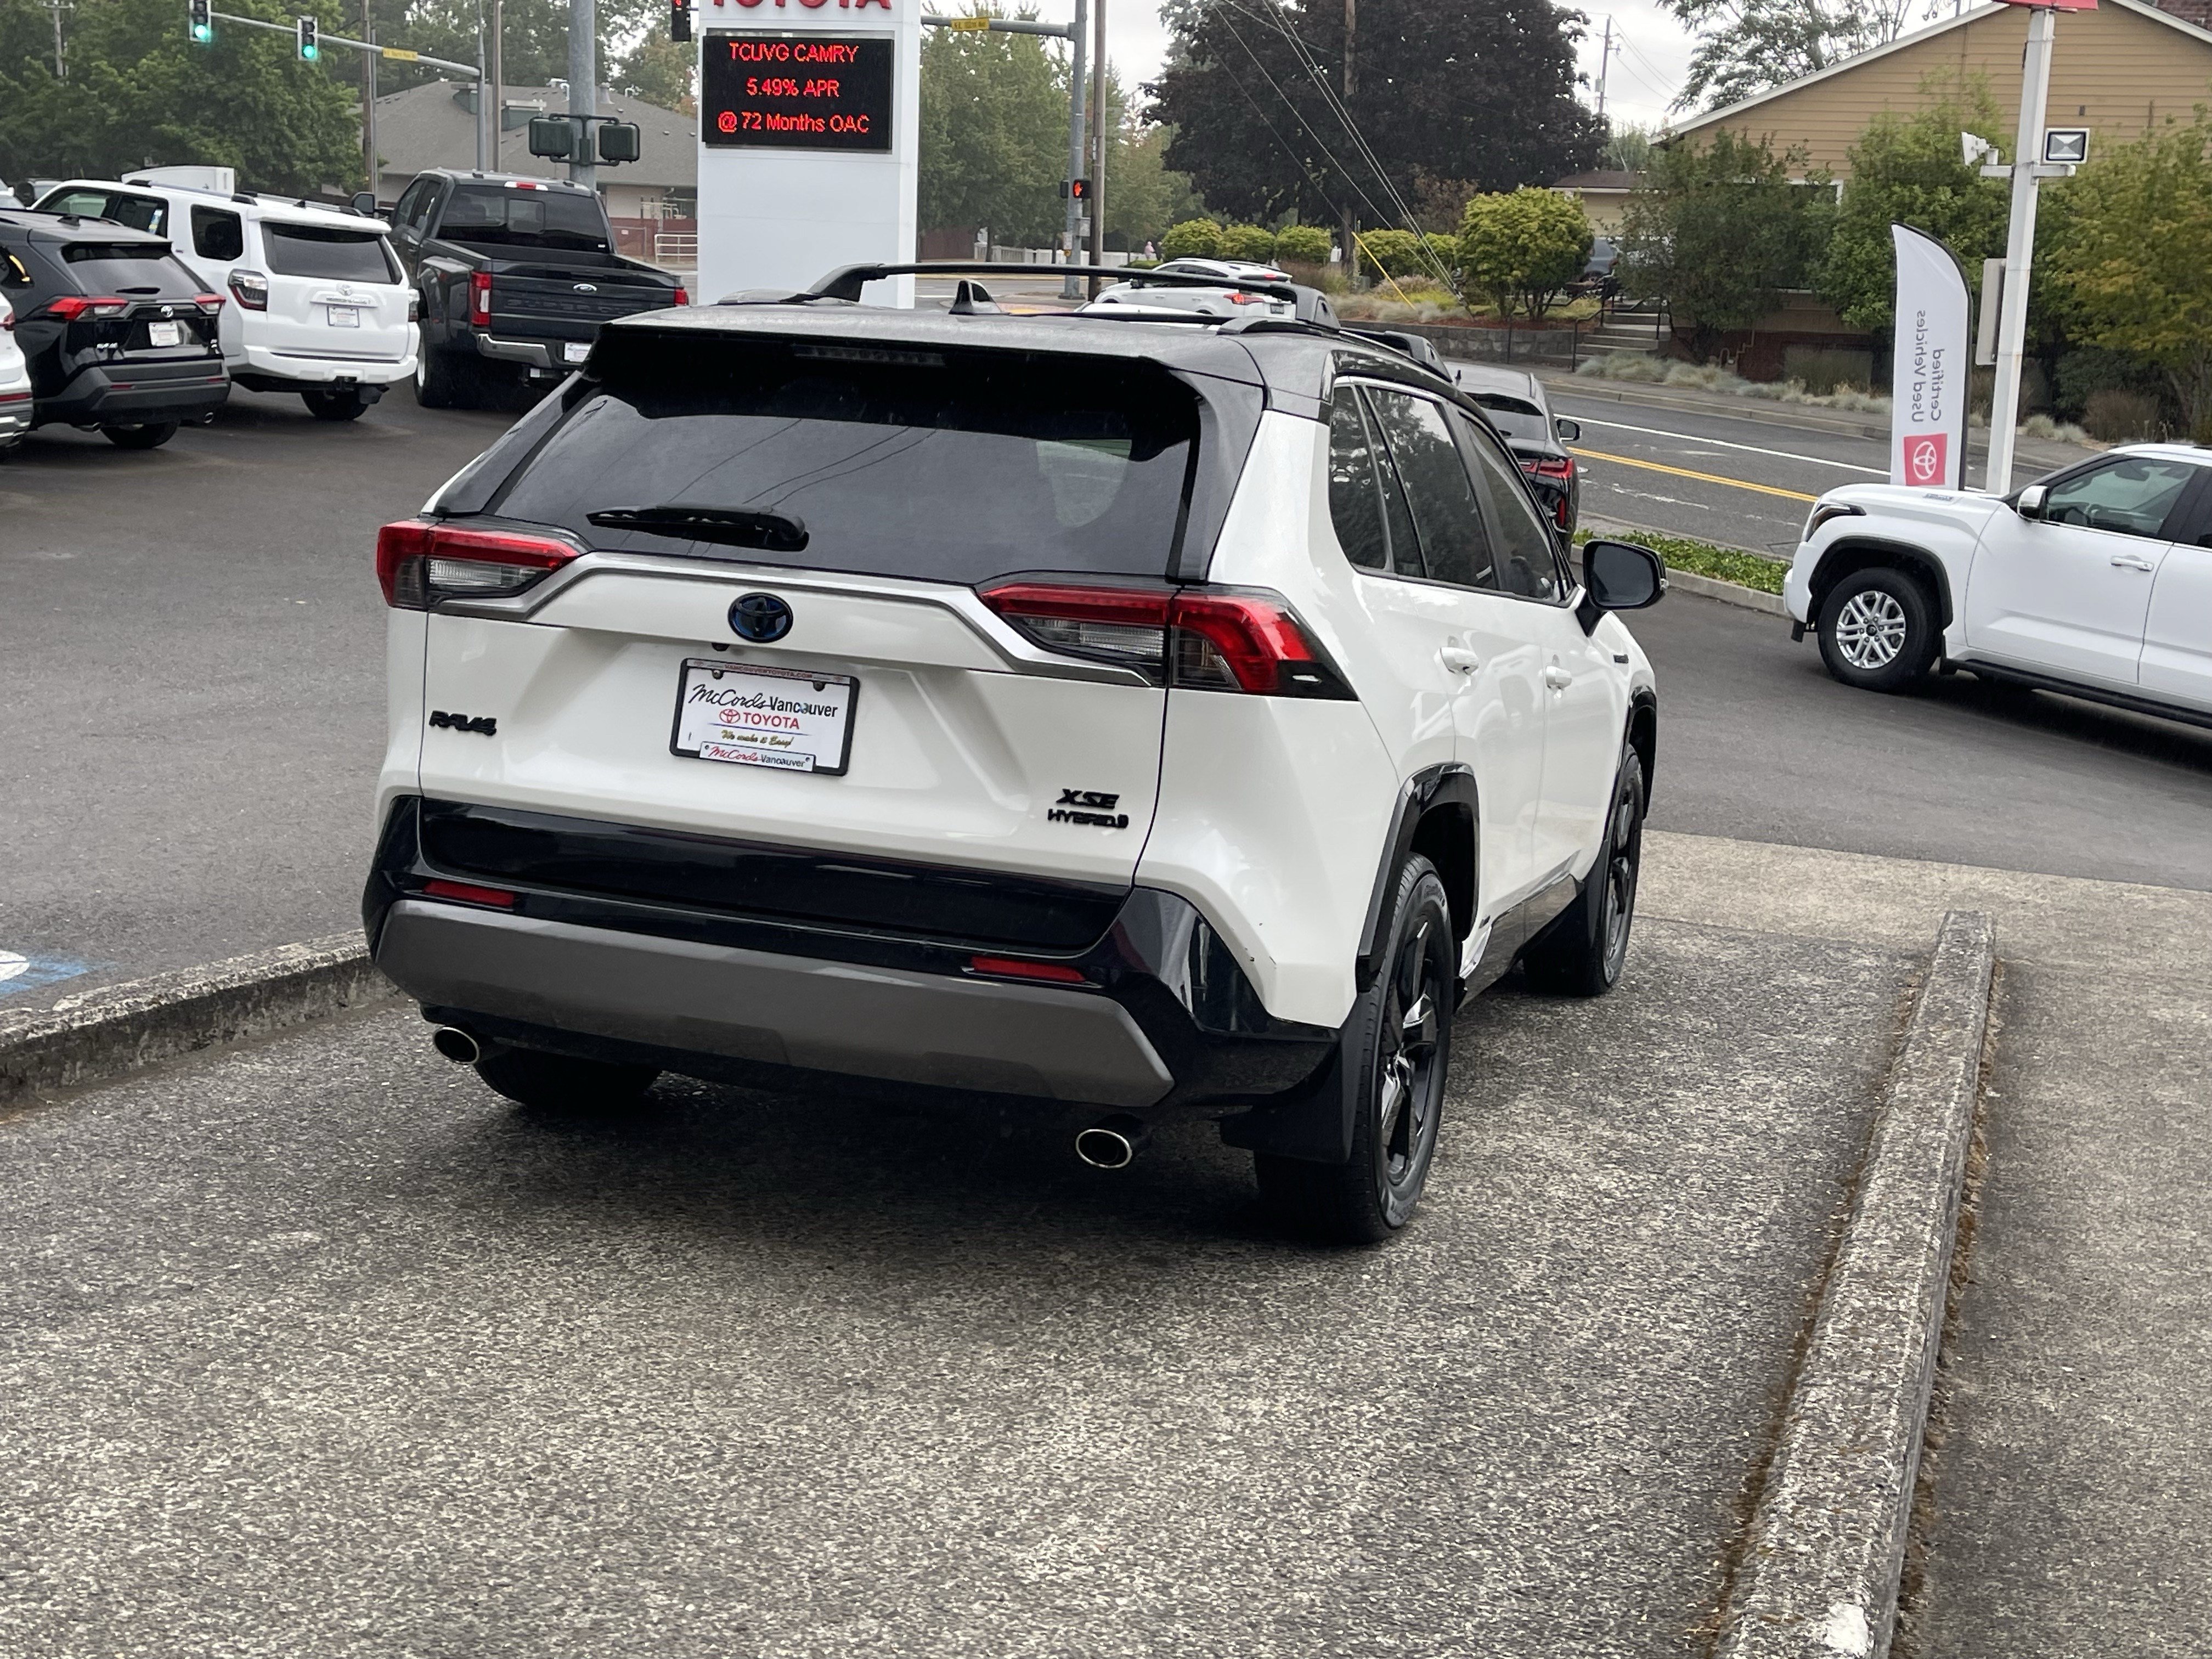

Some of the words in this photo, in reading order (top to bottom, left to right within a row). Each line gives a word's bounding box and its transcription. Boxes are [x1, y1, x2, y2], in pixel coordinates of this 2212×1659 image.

[729, 42, 790, 62] TCUVG
[794, 43, 860, 63] CAMRY
[746, 77, 800, 97] 5.49%
[803, 78, 840, 98] APR
[718, 111, 738, 133] @
[741, 111, 762, 131] 72
[766, 113, 826, 133] Months
[830, 114, 870, 134] OAC
[688, 684, 771, 709] McCords
[428, 710, 497, 736] RAV4
[743, 712, 800, 730] TOYOTA
[1056, 788, 1120, 810] XSE
[1047, 808, 1116, 827] HYBRID
